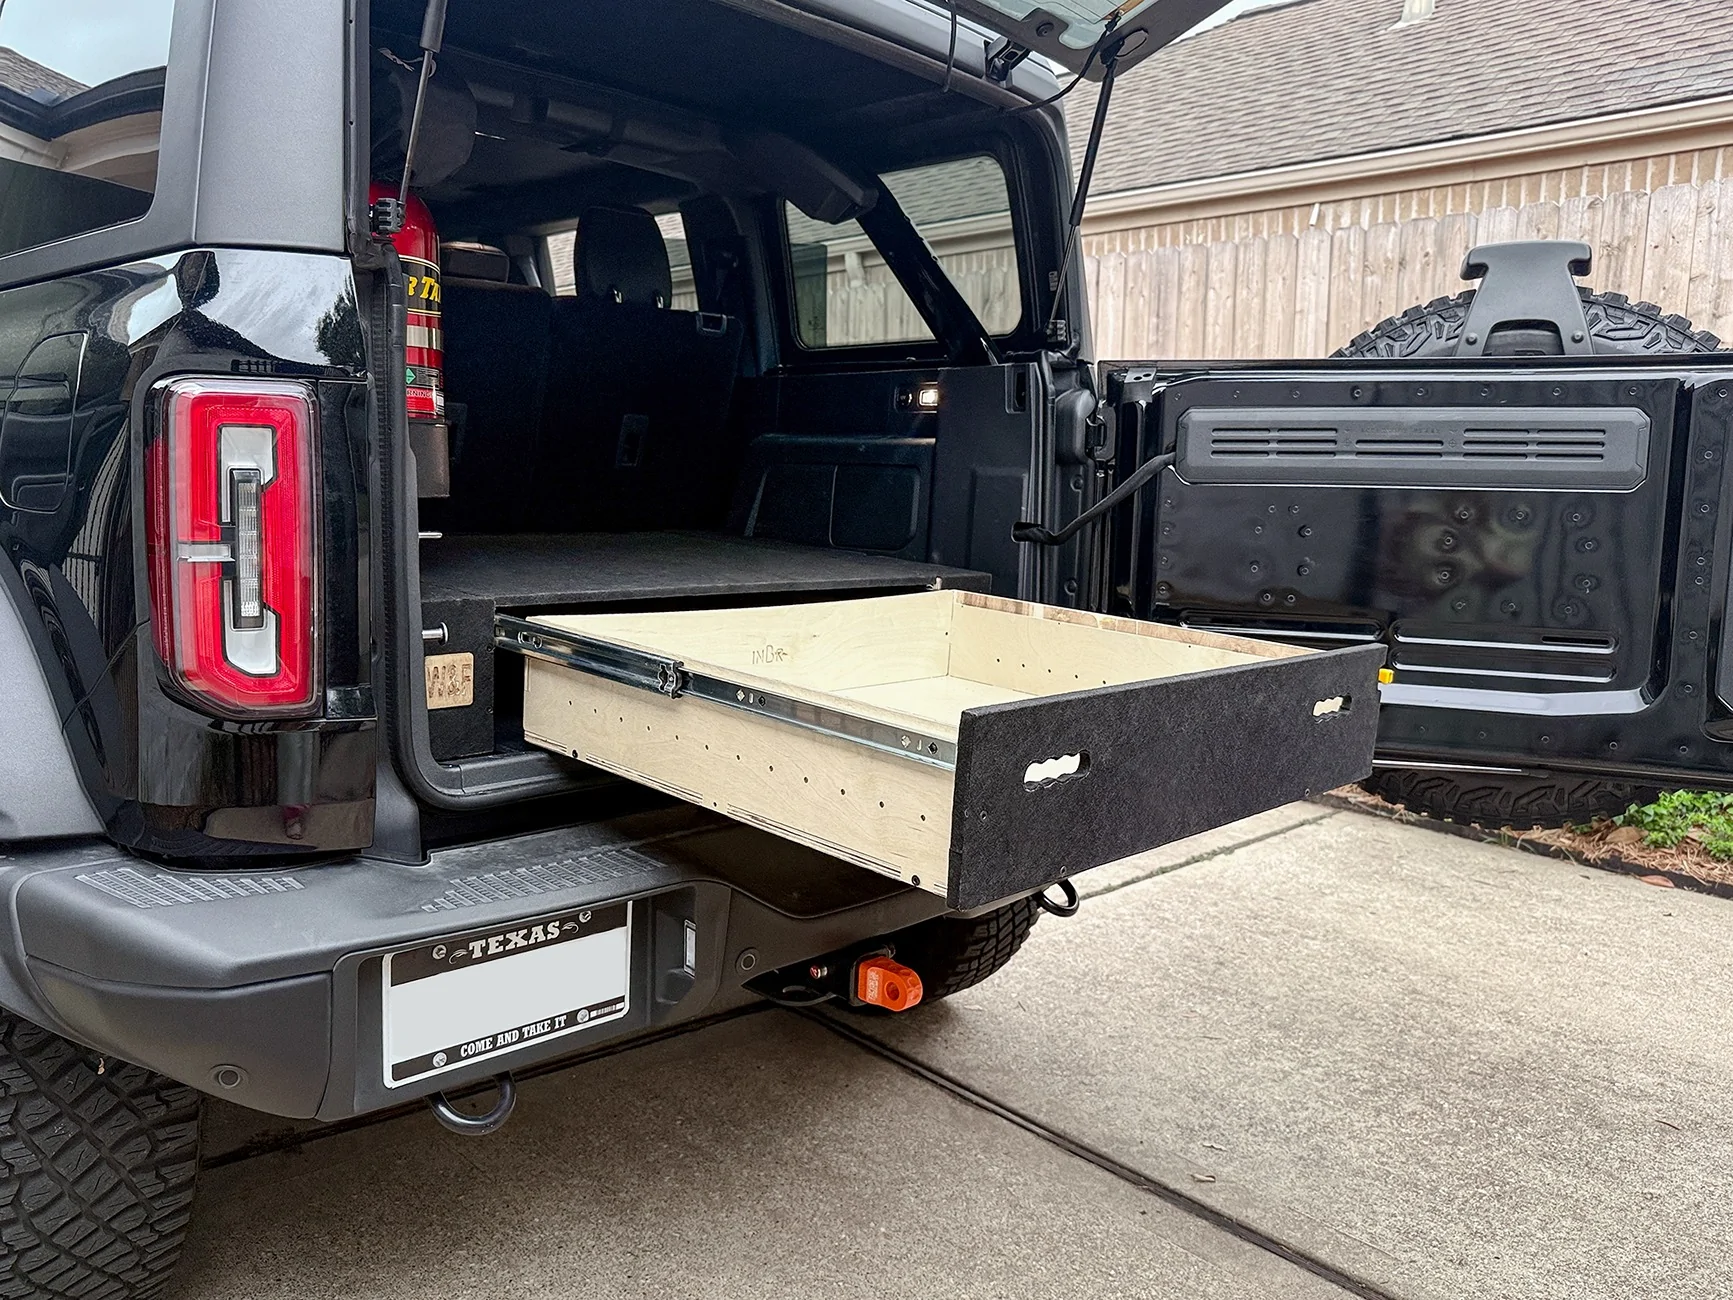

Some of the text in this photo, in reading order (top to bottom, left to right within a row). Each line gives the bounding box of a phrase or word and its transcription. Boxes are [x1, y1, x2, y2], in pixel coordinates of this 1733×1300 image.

[469, 921, 560, 958] TEXAS
[460, 1014, 567, 1057] COME AND TAKE IT
